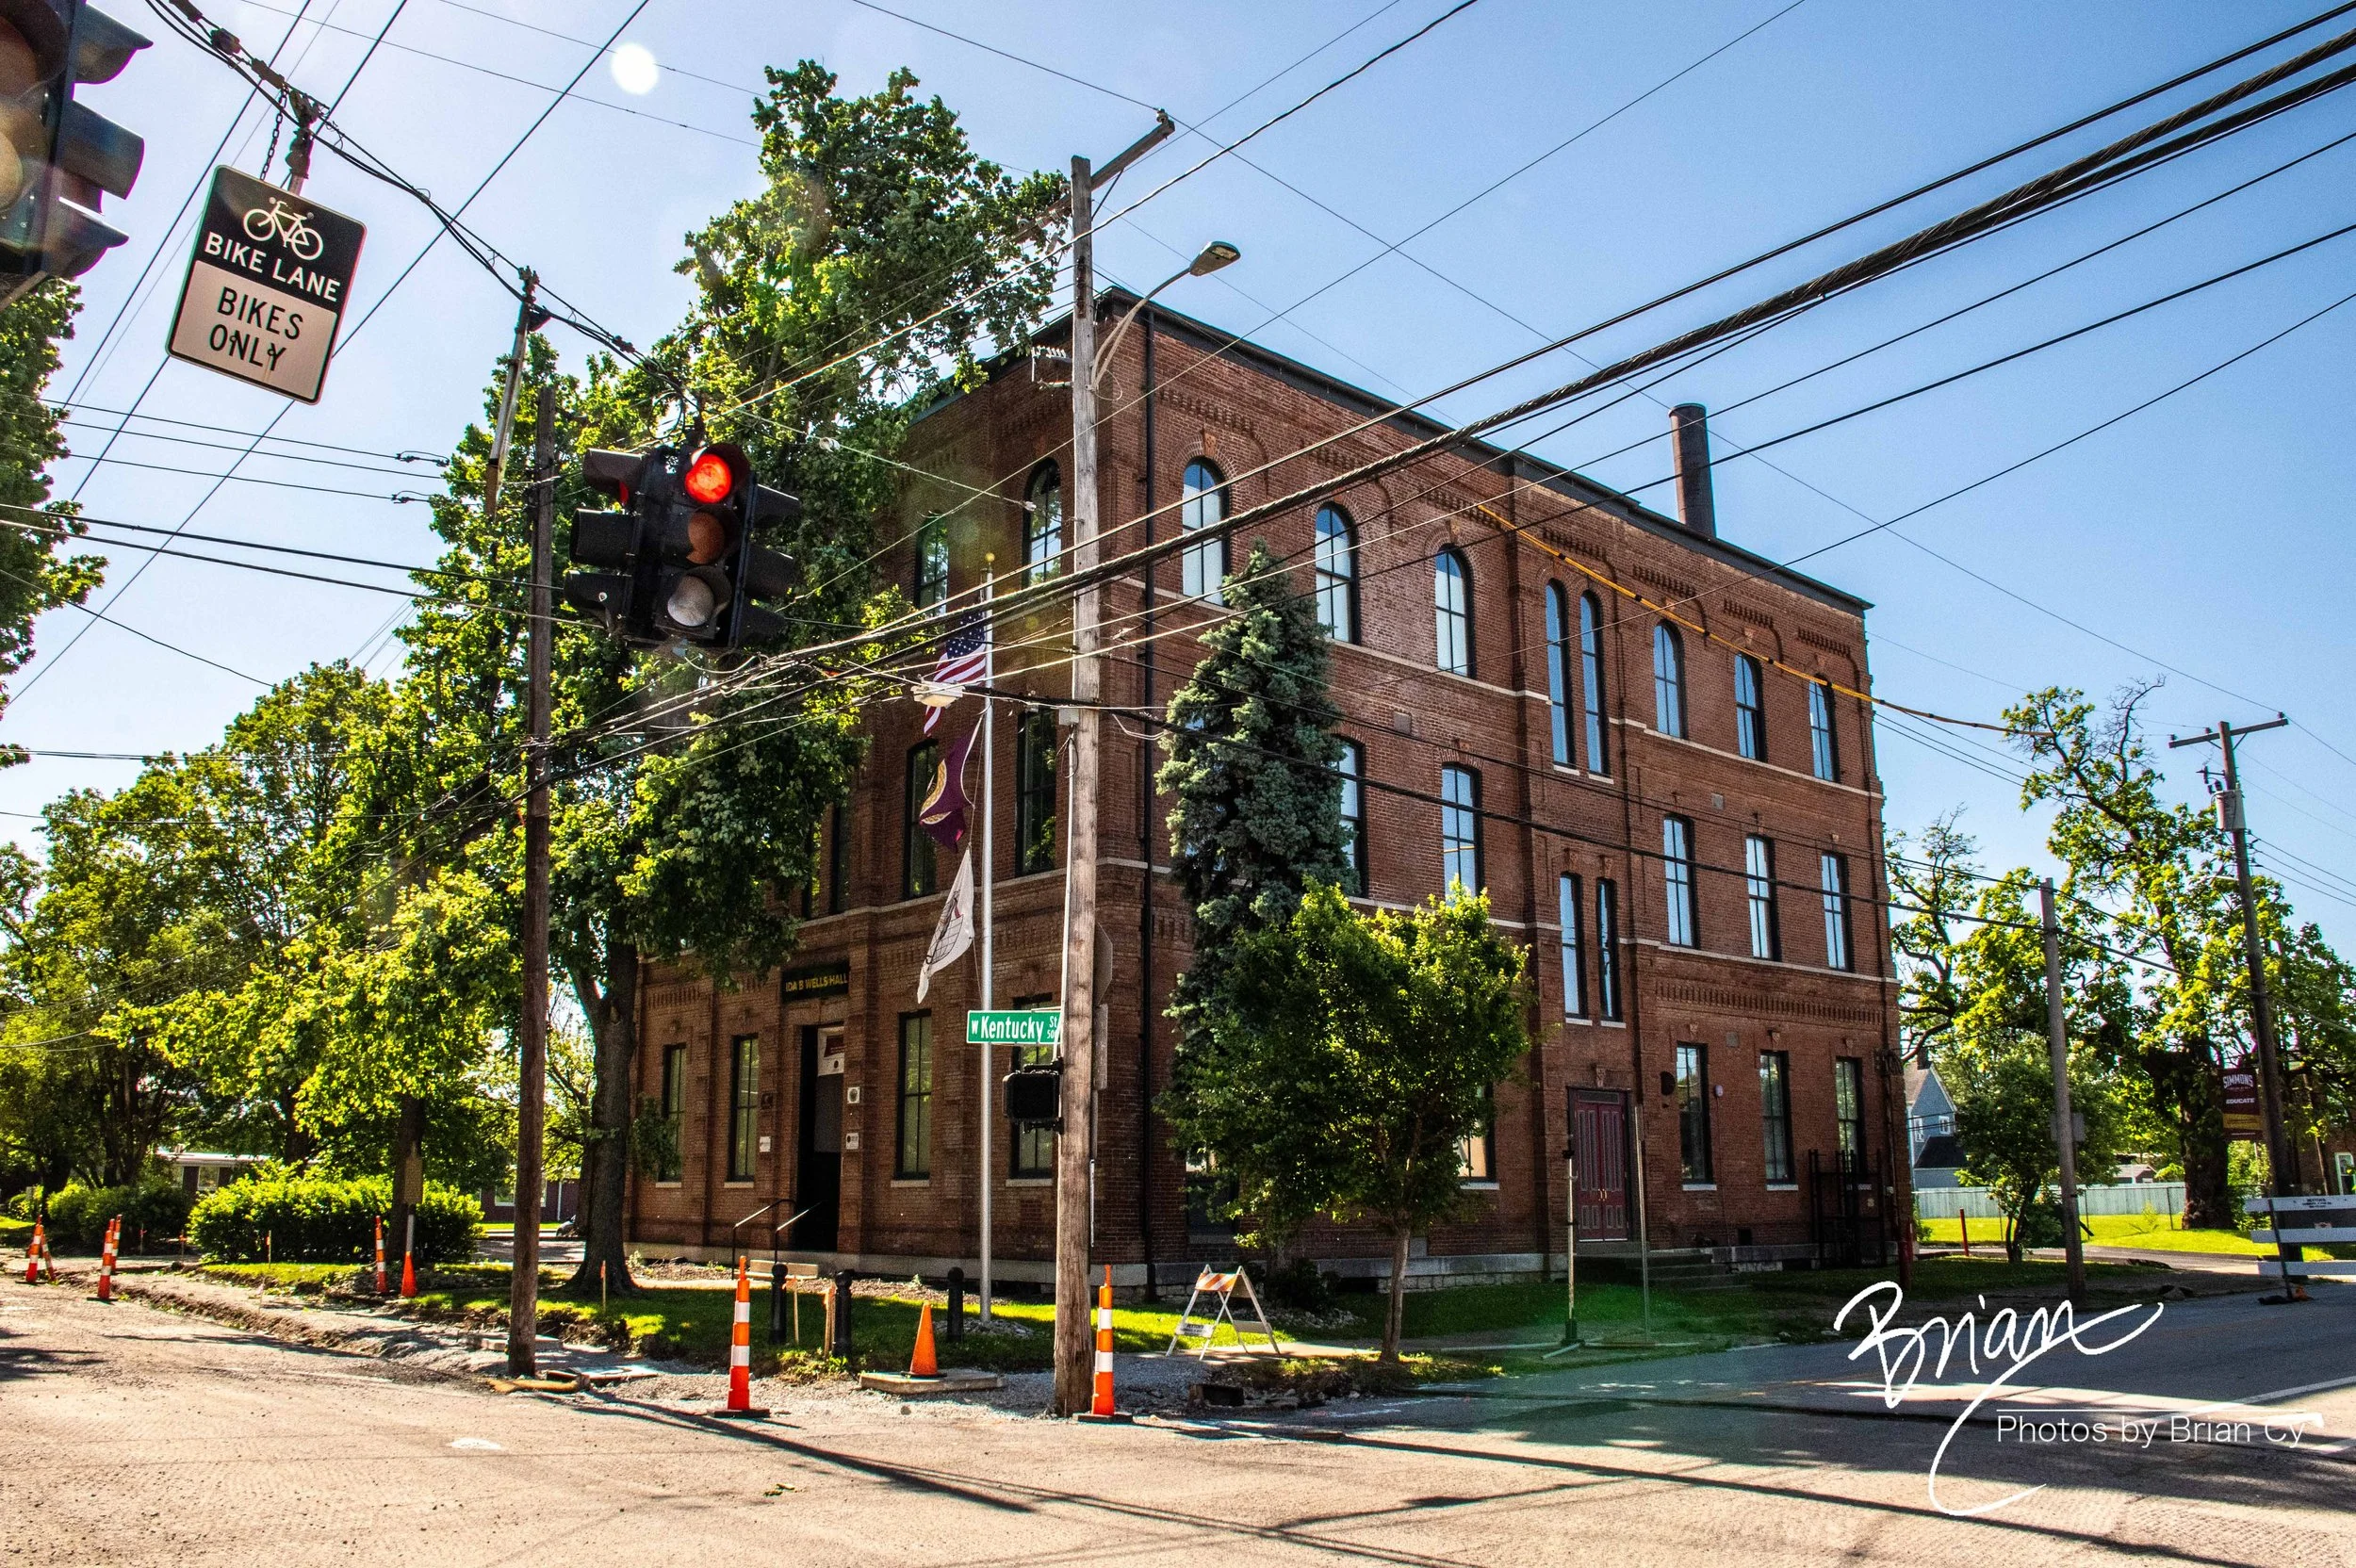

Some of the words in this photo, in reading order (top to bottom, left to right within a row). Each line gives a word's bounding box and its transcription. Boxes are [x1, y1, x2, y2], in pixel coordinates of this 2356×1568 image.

[204, 231, 267, 273] BIKE
[271, 258, 341, 302] LANE
[216, 286, 304, 340] BIKES
[208, 323, 287, 371] ONLY
[785, 981, 797, 992] IDA
[798, 980, 804, 990] B
[806, 976, 828, 989] WELLS
[829, 973, 848, 986] HALL
[972, 1020, 979, 1035] W
[980, 1016, 1044, 1043] Kentucky
[1049, 1015, 1057, 1028] St
[2222, 1073, 2254, 1089] SIMMONS
